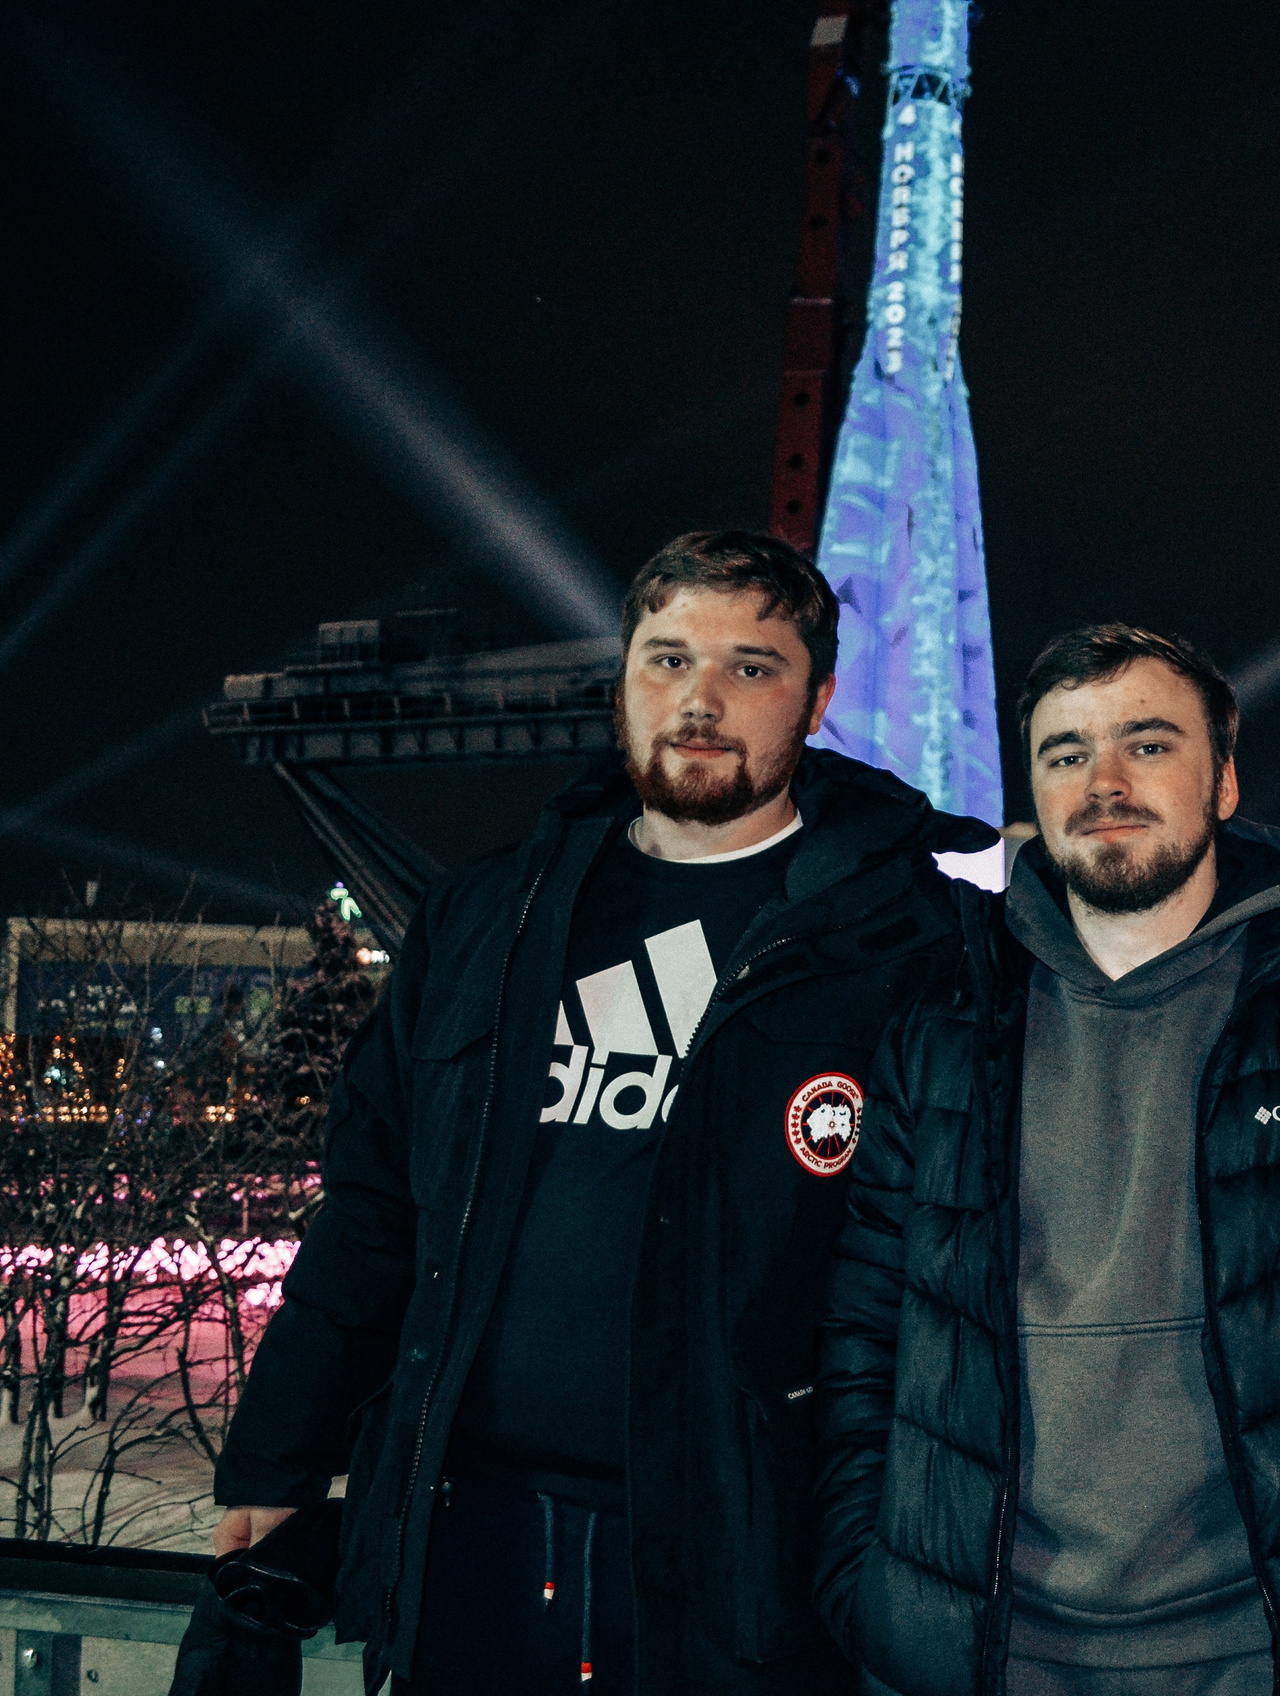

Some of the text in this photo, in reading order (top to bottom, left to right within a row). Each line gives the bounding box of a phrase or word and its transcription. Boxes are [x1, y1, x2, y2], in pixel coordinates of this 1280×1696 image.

[802, 1081, 860, 1102] CANADA GOOSE
[800, 1146, 852, 1170] ARCTIC PROGRAM
